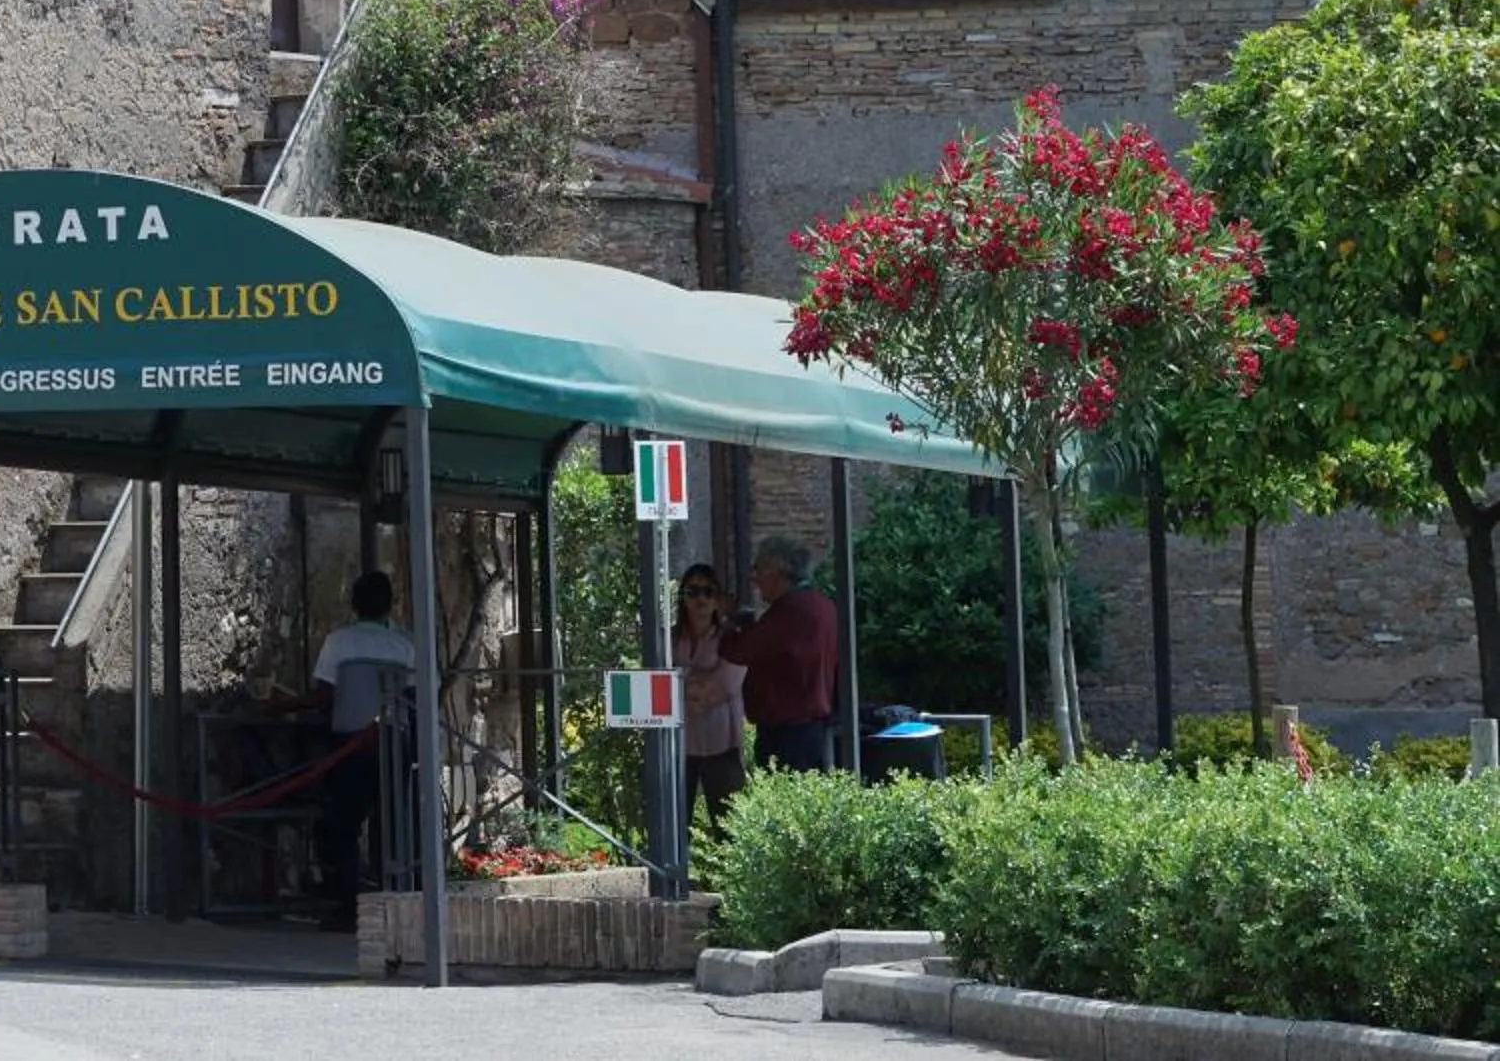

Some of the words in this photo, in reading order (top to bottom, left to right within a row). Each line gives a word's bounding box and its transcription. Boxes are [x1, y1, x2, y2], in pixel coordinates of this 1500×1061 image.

[16, 289, 102, 325] SAN
[115, 281, 339, 323] CALLISTO
[141, 361, 241, 388] ENTRÉE
[267, 362, 383, 386] EINGANG
